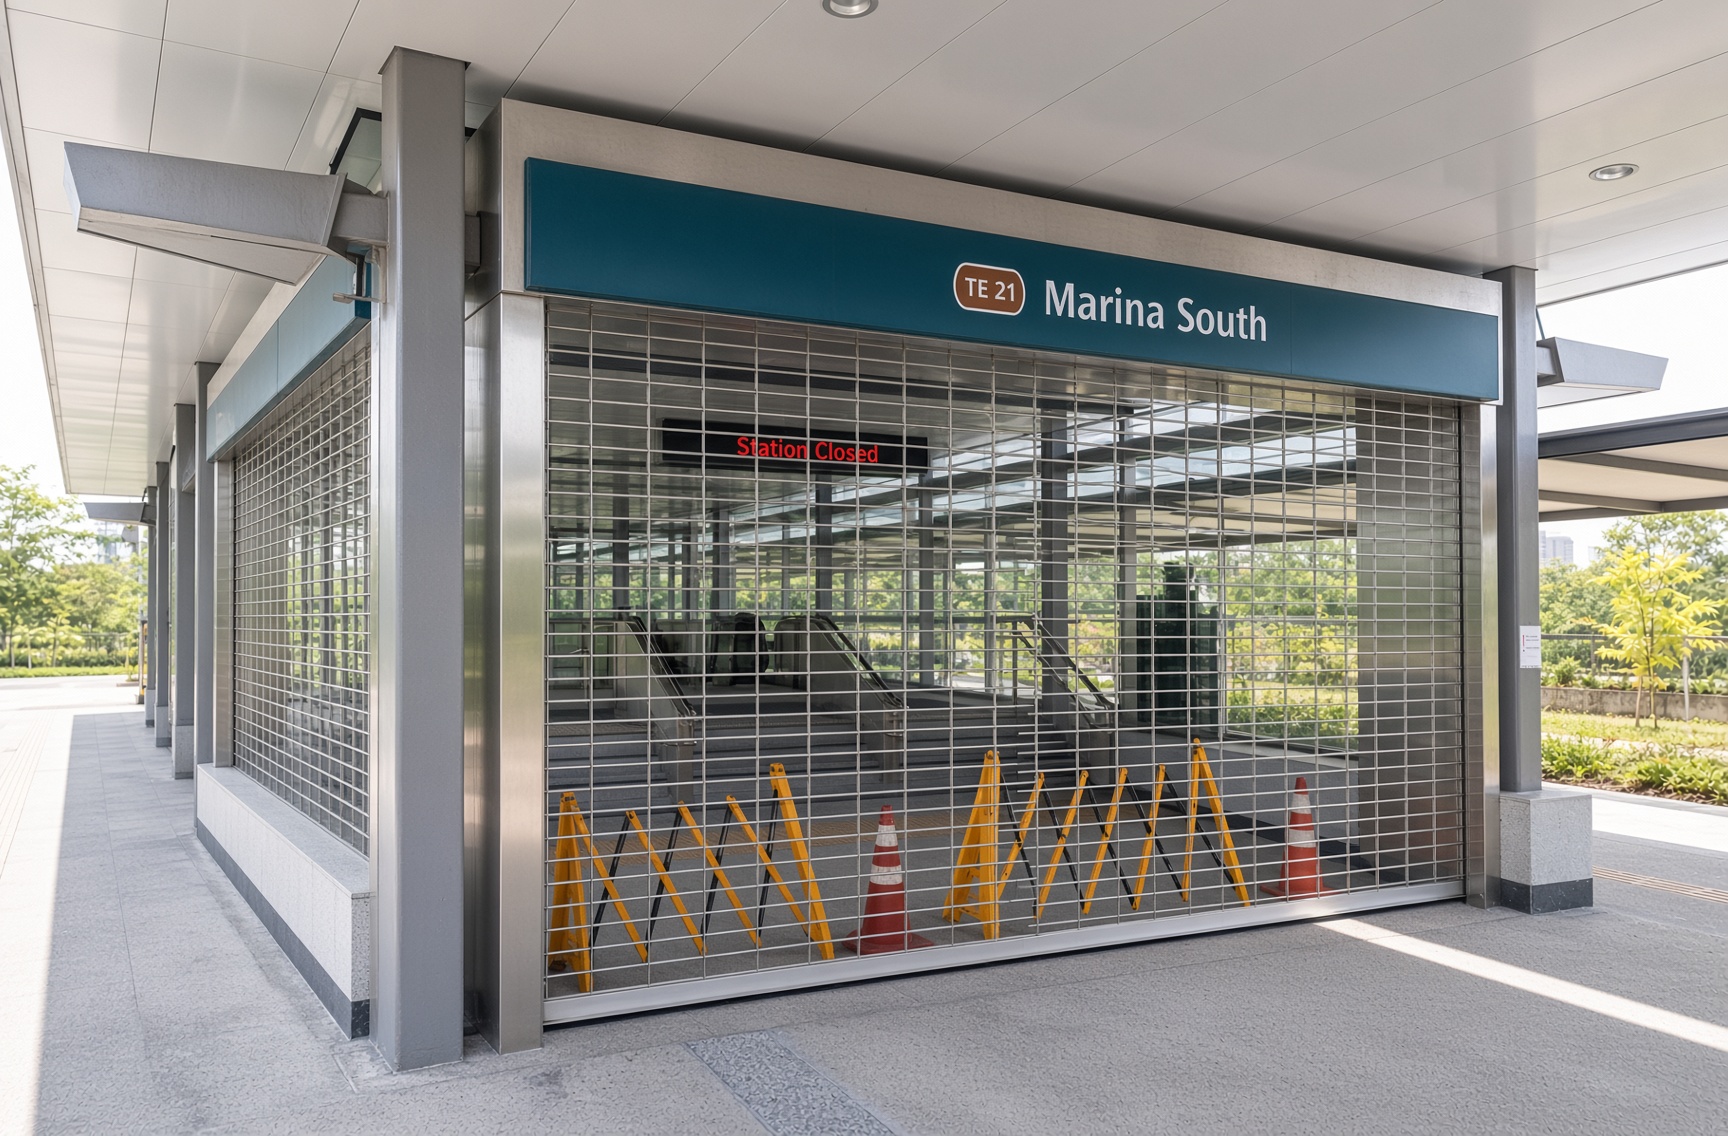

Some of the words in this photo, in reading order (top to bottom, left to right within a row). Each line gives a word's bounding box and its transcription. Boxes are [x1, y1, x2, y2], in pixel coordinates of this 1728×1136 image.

[964, 277, 989, 299] TE
[994, 281, 1015, 302] 21
[1045, 279, 1164, 329] Marina
[1177, 297, 1267, 342] South
[737, 436, 808, 459] Station
[815, 441, 879, 463] Closed
